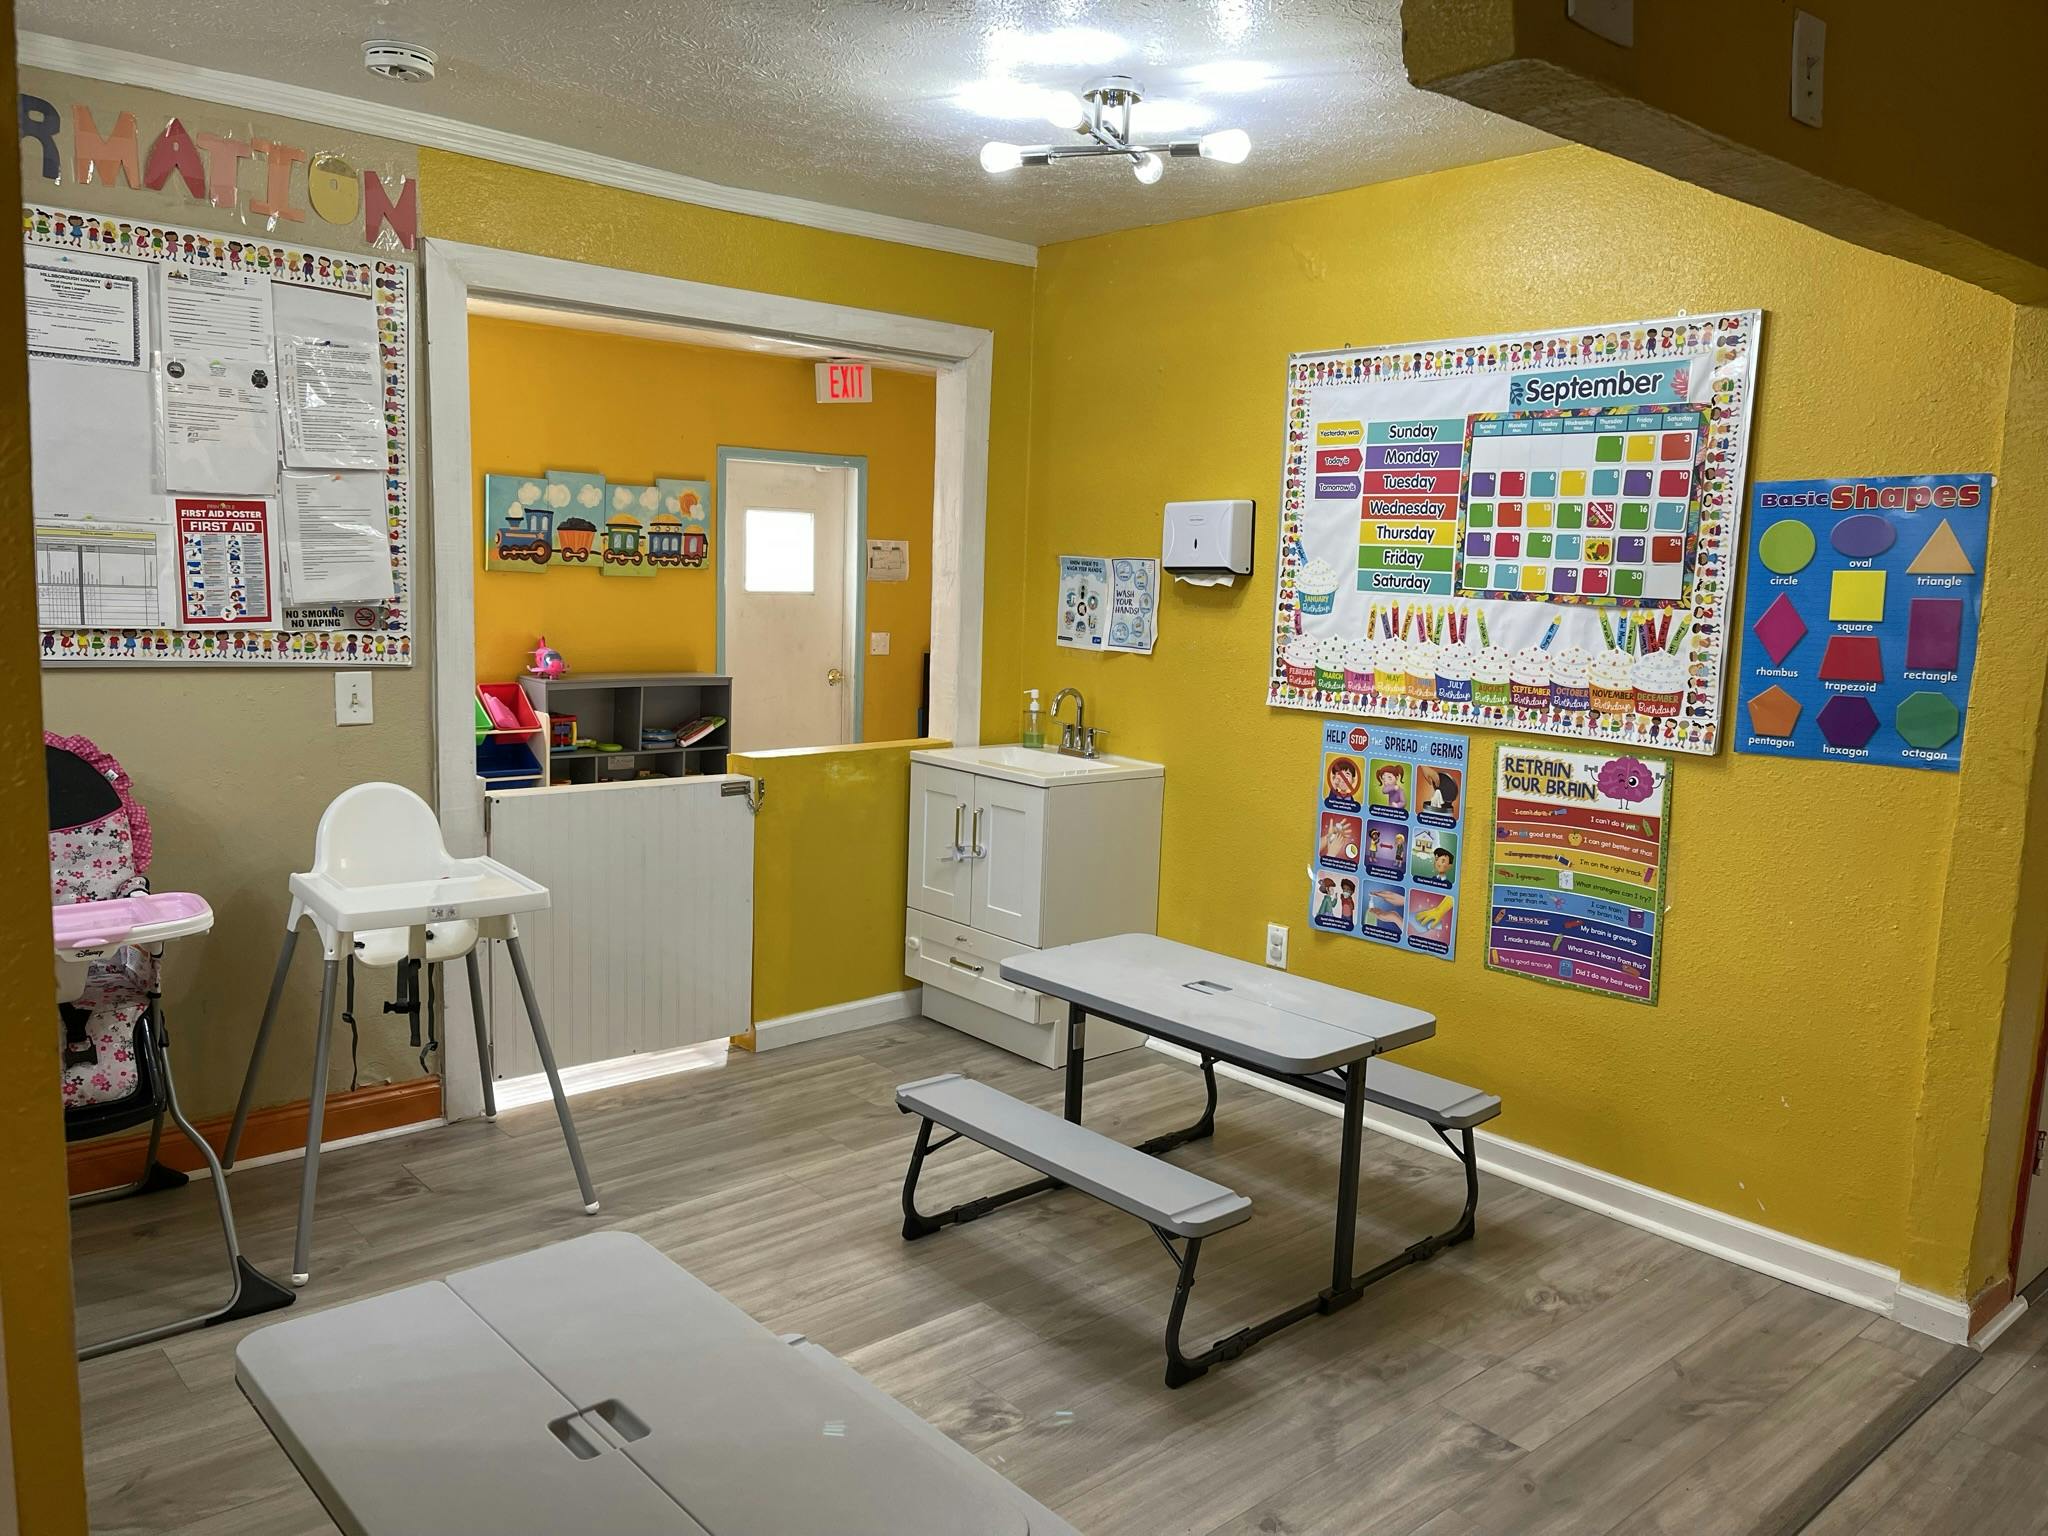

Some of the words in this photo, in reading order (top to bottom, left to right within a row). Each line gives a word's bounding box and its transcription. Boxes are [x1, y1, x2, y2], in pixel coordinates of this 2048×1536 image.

[829, 364, 864, 399] EXIT
[1526, 370, 1662, 406] September
[1389, 424, 1438, 440] Sunday
[1325, 457, 1343, 465] Today
[1385, 449, 1438, 465] Monday
[1680, 472, 1688, 480] 10
[1320, 483, 1349, 491] Tomorrow
[1384, 474, 1435, 491] Tuesday
[1761, 492, 1828, 508] Basic
[1830, 484, 1980, 512] Shapes
[1370, 501, 1444, 518] Wednesday
[191, 522, 227, 531] FIRST
[233, 522, 255, 531] AID
[1377, 525, 1434, 542] Thursday
[1384, 550, 1423, 566] Friday
[1849, 558, 1872, 568] oval
[1374, 574, 1430, 592] Saturday
[1770, 576, 1798, 586] circle
[1917, 576, 1962, 587] triangle
[286, 610, 298, 618] NO
[302, 610, 344, 618] SMOKING
[306, 619, 340, 627] VAPING
[1837, 622, 1873, 633] square
[1756, 668, 1798, 678] rhombus
[1904, 671, 1958, 682] rectangle
[1448, 681, 1464, 689] JULY
[1824, 681, 1876, 692] trapezoid
[1512, 686, 1551, 696] SEPTEMBER
[1556, 688, 1588, 697] OCTOBER
[1593, 690, 1633, 699] NOVEMBER
[1637, 694, 1679, 703] DECEMBER
[1326, 729, 1346, 744] HELP
[1350, 734, 1367, 745] STOP
[1371, 737, 1382, 745] the
[1385, 736, 1418, 753] SPREAD
[1430, 742, 1463, 760] GERMS
[1748, 736, 1795, 748] pentagon
[1822, 744, 1869, 757] hexagon
[1902, 748, 1948, 760] octagon
[1505, 757, 1572, 779] RETRAIN
[1504, 775, 1541, 792] YOUR
[1546, 779, 1596, 800] BRAIN
[1612, 843, 1630, 851] better
[1576, 880, 1591, 888] What
[1640, 895, 1651, 903] try?
[1598, 910, 1612, 918] brain
[1581, 926, 1589, 934] My
[1591, 927, 1606, 937] brain
[1601, 952, 1616, 961] learn
[1617, 957, 1632, 966] from
[1633, 961, 1646, 970] this?
[1610, 977, 1623, 986] best
[1624, 982, 1642, 991] work?
